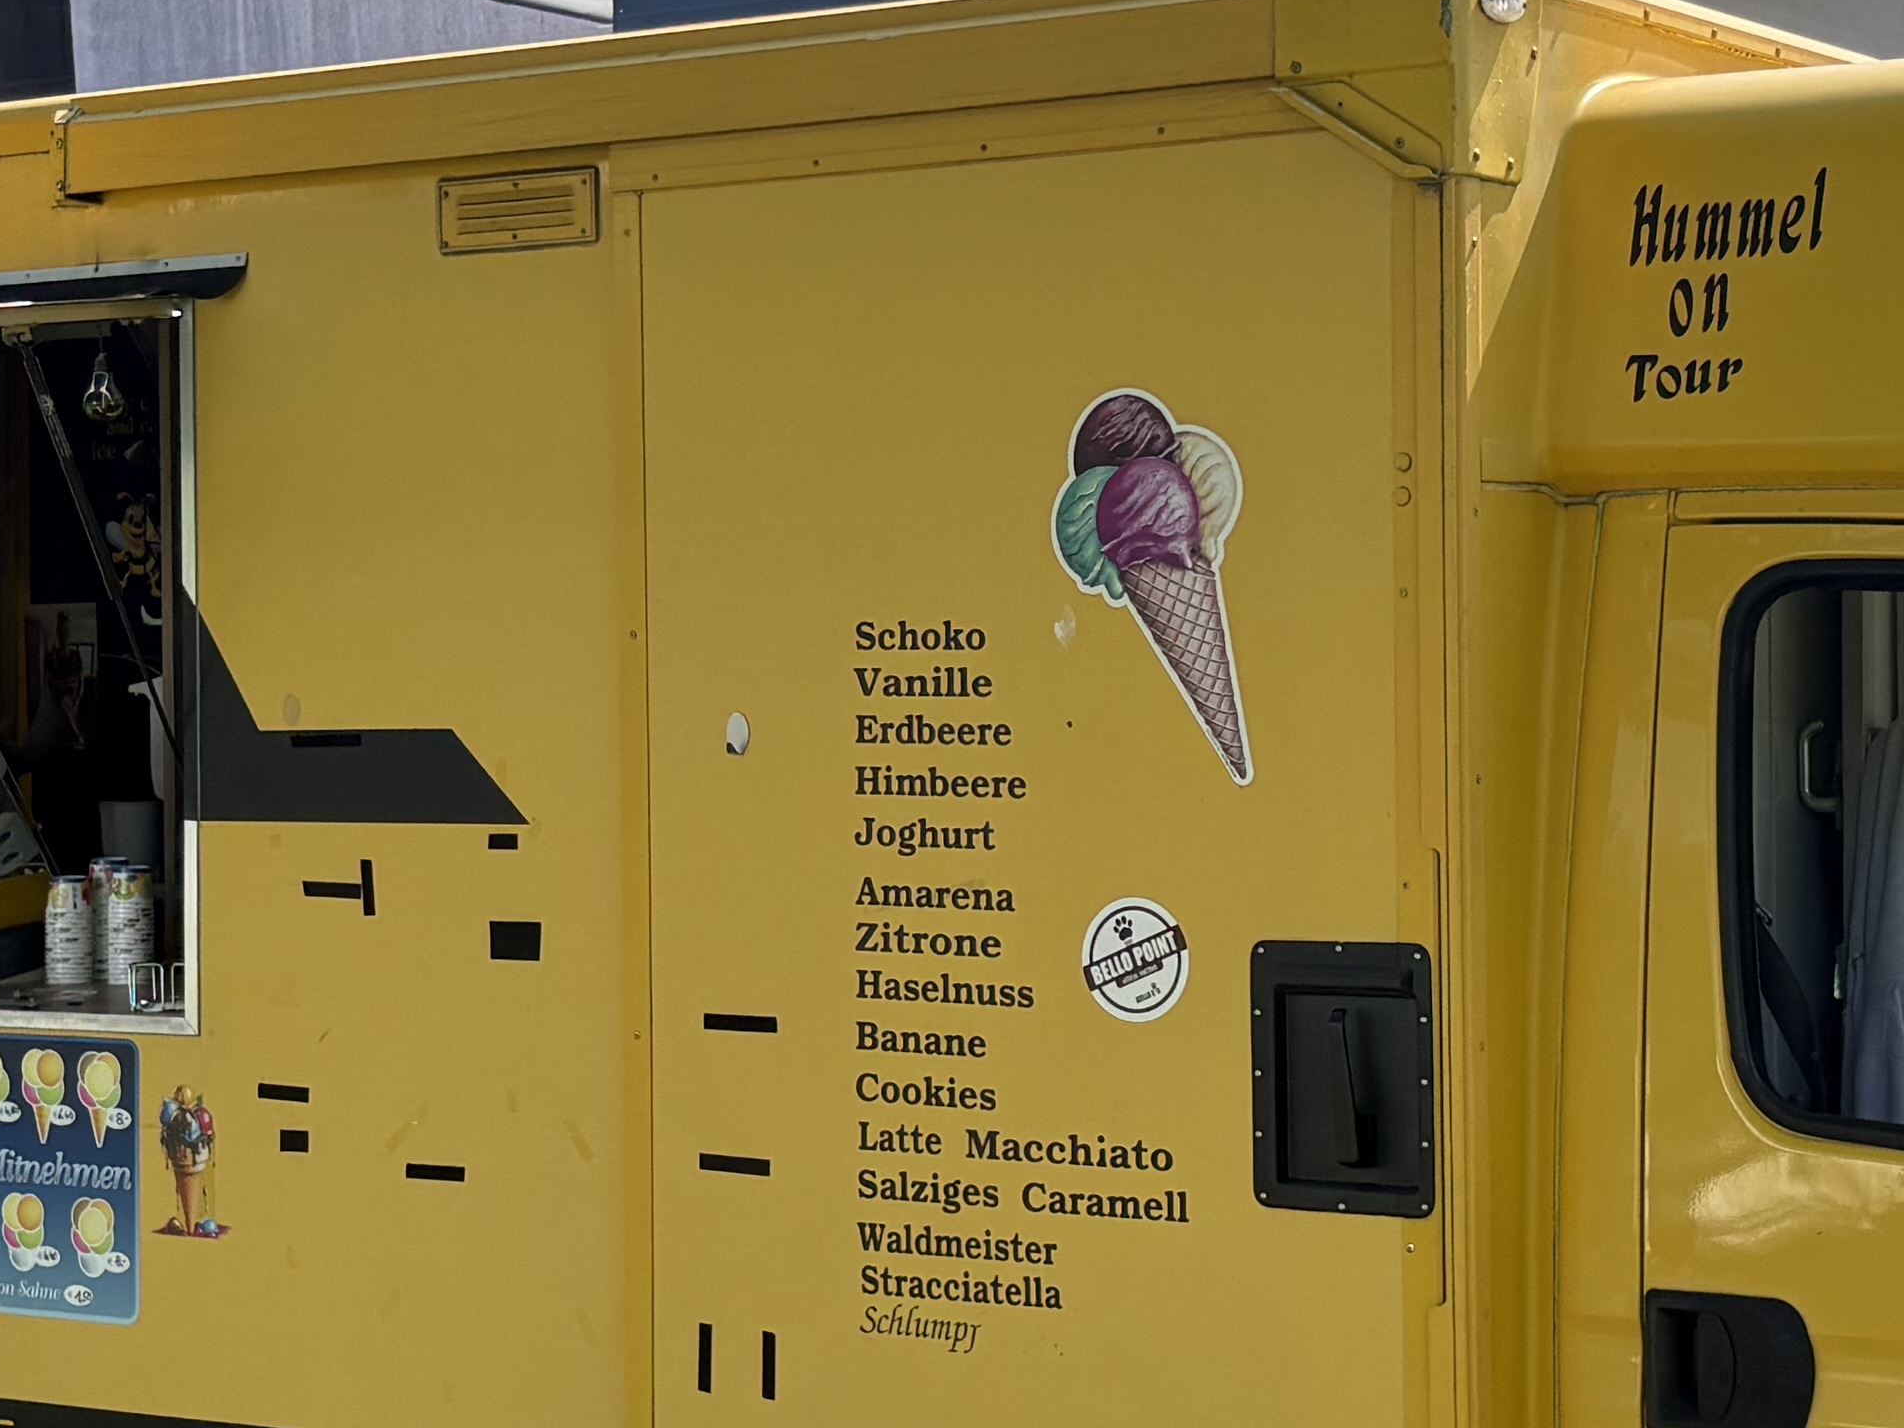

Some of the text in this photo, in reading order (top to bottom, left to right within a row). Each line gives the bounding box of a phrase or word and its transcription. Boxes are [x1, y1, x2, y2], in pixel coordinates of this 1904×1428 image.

[1629, 166, 1827, 267] Hummel
[1625, 354, 1744, 403] Tour
[855, 619, 986, 651] Schoko
[853, 665, 993, 698] Vanille
[855, 714, 1012, 746] Erdbeere
[854, 765, 1027, 800] Himbeere
[854, 817, 996, 857] Joghurt
[855, 876, 1016, 912] Amarena
[855, 921, 1002, 959] Zitrone
[1089, 951, 1134, 986] BELLO
[1132, 930, 1178, 967] POINT
[856, 969, 1034, 1009] Haselnuss
[855, 1021, 987, 1058] Banane
[855, 1072, 997, 1111] Cookies
[858, 1121, 1174, 1172] Latte Macchiato
[858, 1169, 1190, 1223] Salziges Caramell
[856, 1221, 1058, 1266] Waldmeister
[17, 1280, 62, 1301] Sahne
[861, 1264, 1063, 1310] Stracciatella
[859, 1305, 981, 1354] Schlumpf
